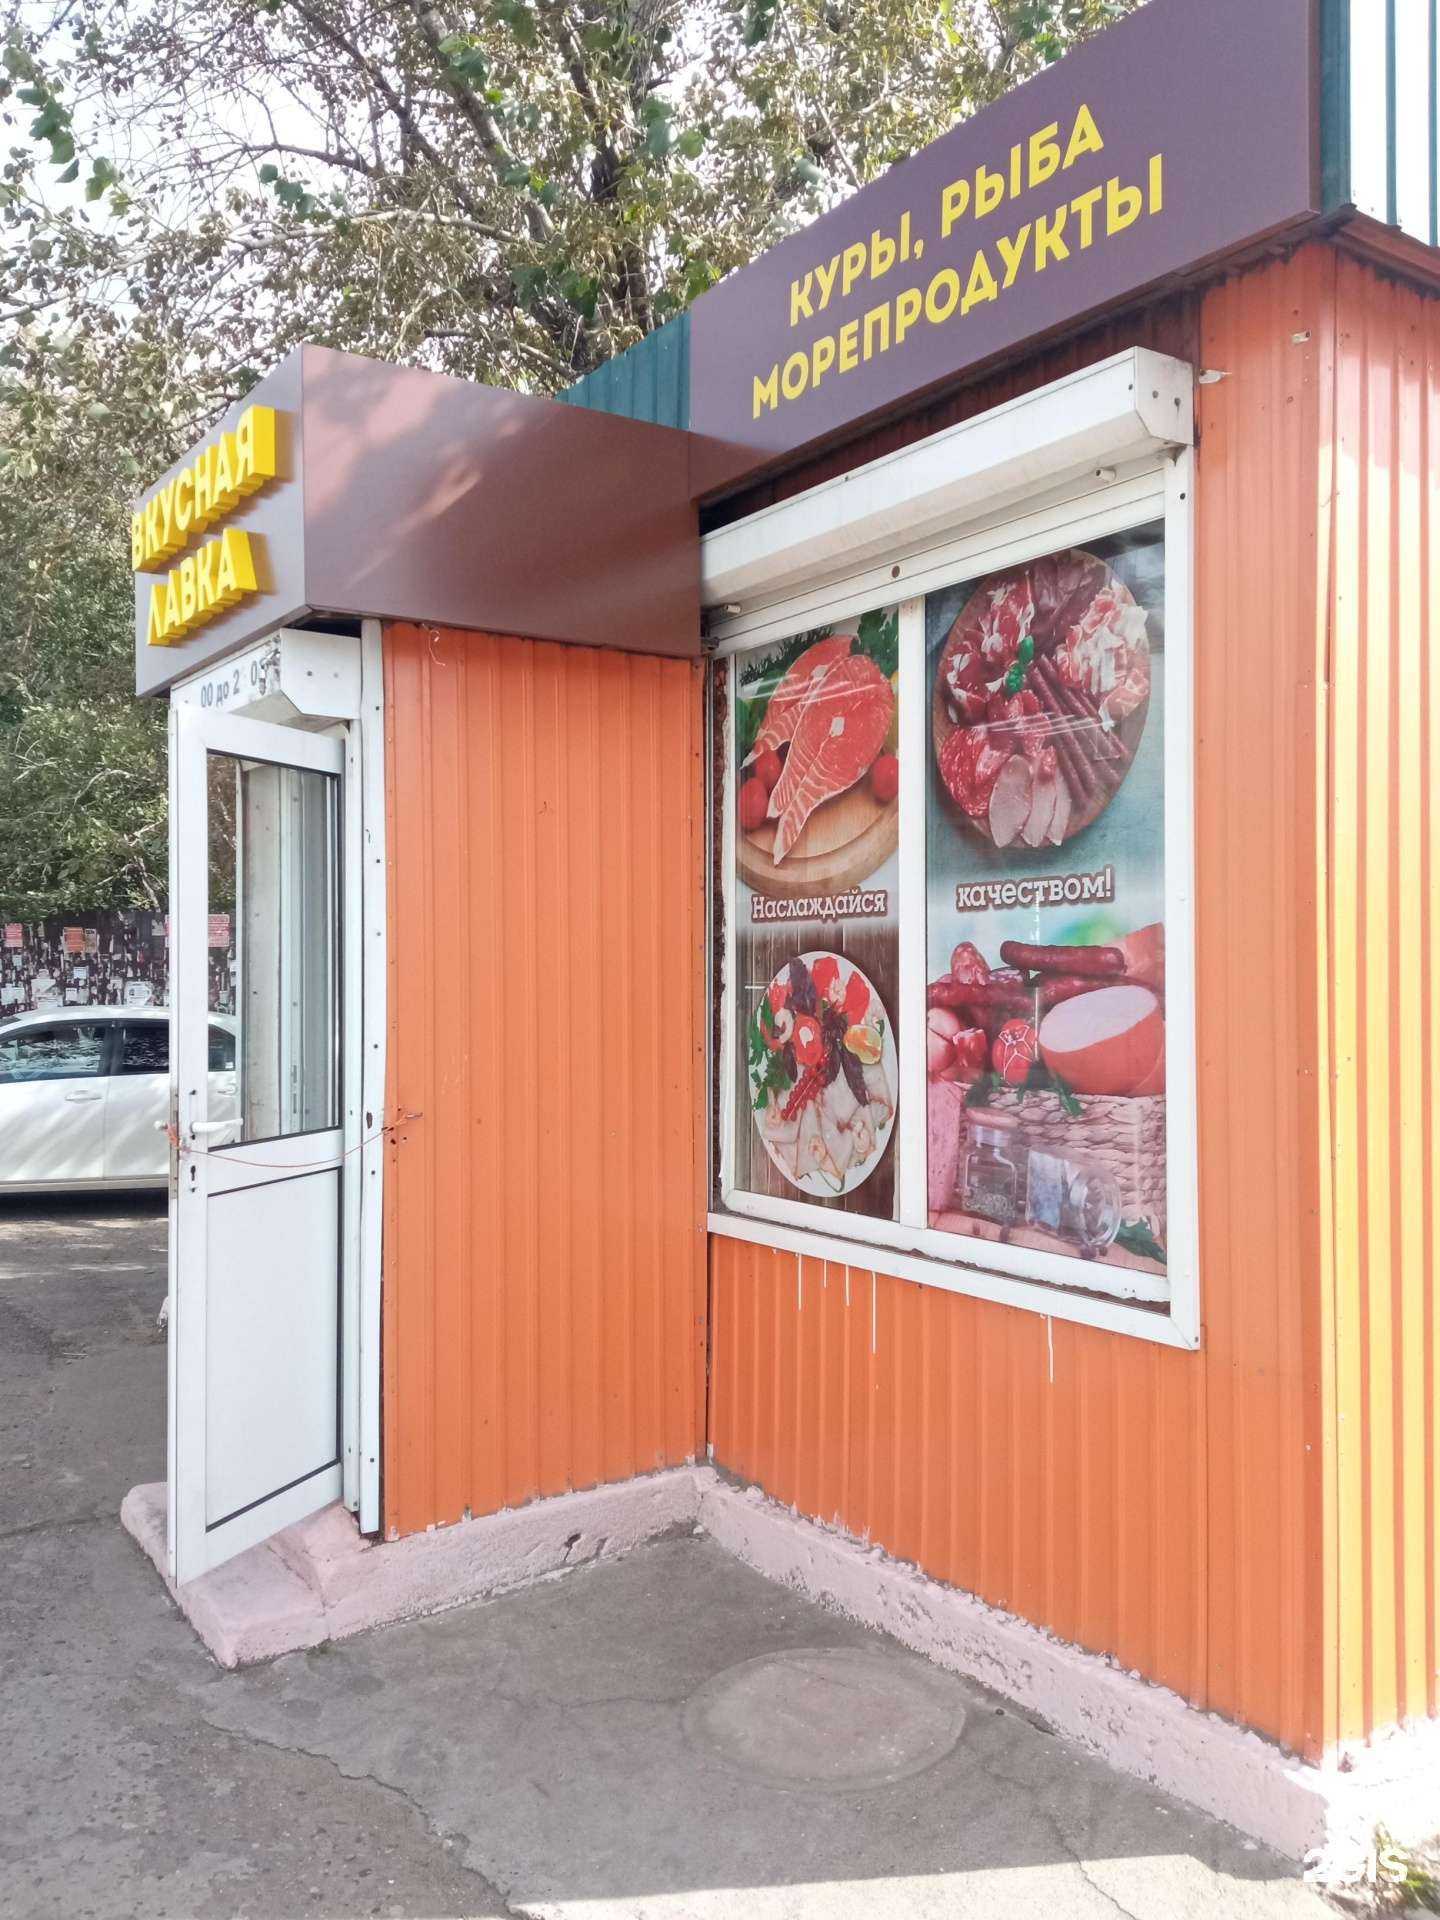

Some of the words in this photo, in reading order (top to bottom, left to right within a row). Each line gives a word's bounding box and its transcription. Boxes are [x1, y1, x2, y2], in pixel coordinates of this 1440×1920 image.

[752, 152, 1164, 420] МОРЕПРОДУКТЫ
[789, 209, 925, 327] КУРЫ,
[941, 103, 1104, 240] РЫБА
[131, 404, 275, 571] ВКУСНАЯ
[147, 527, 258, 647] ЛАВКА
[752, 887, 887, 922] Наслаждайся
[957, 867, 1112, 909] качеством!
